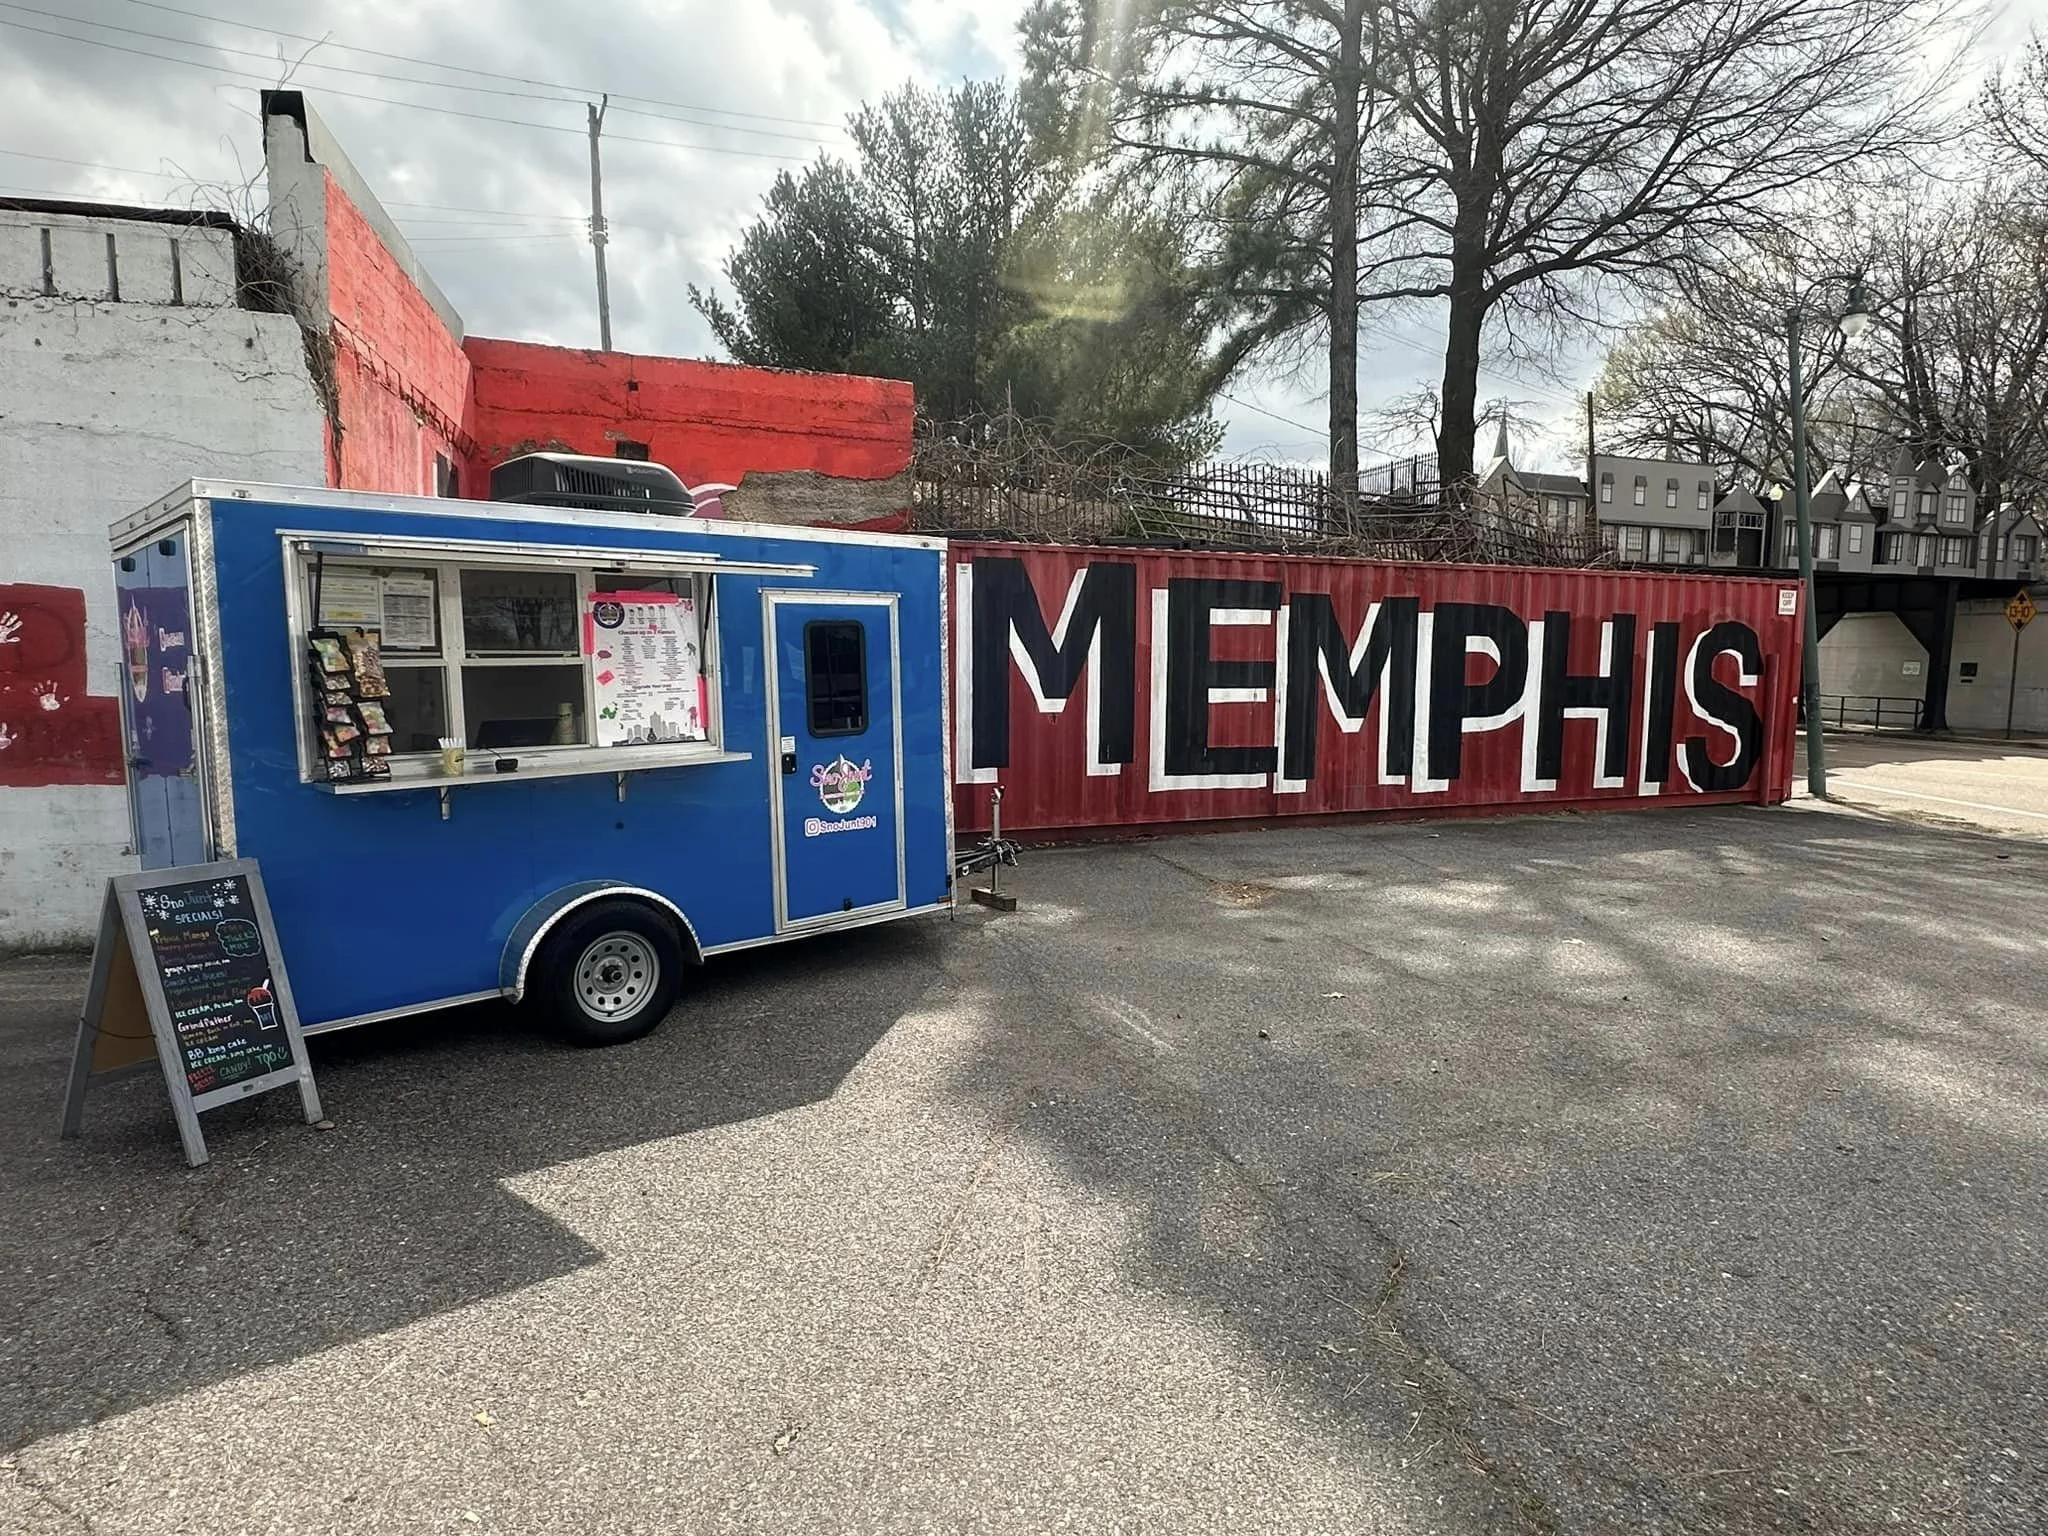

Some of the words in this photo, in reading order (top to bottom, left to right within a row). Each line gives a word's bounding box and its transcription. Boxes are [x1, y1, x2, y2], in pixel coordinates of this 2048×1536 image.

[956, 556, 1762, 797] MEMPHIS
[820, 815, 877, 833] SnoJunt901
[175, 910, 224, 925] SPECIALS!
[187, 1048, 205, 1061] BB
